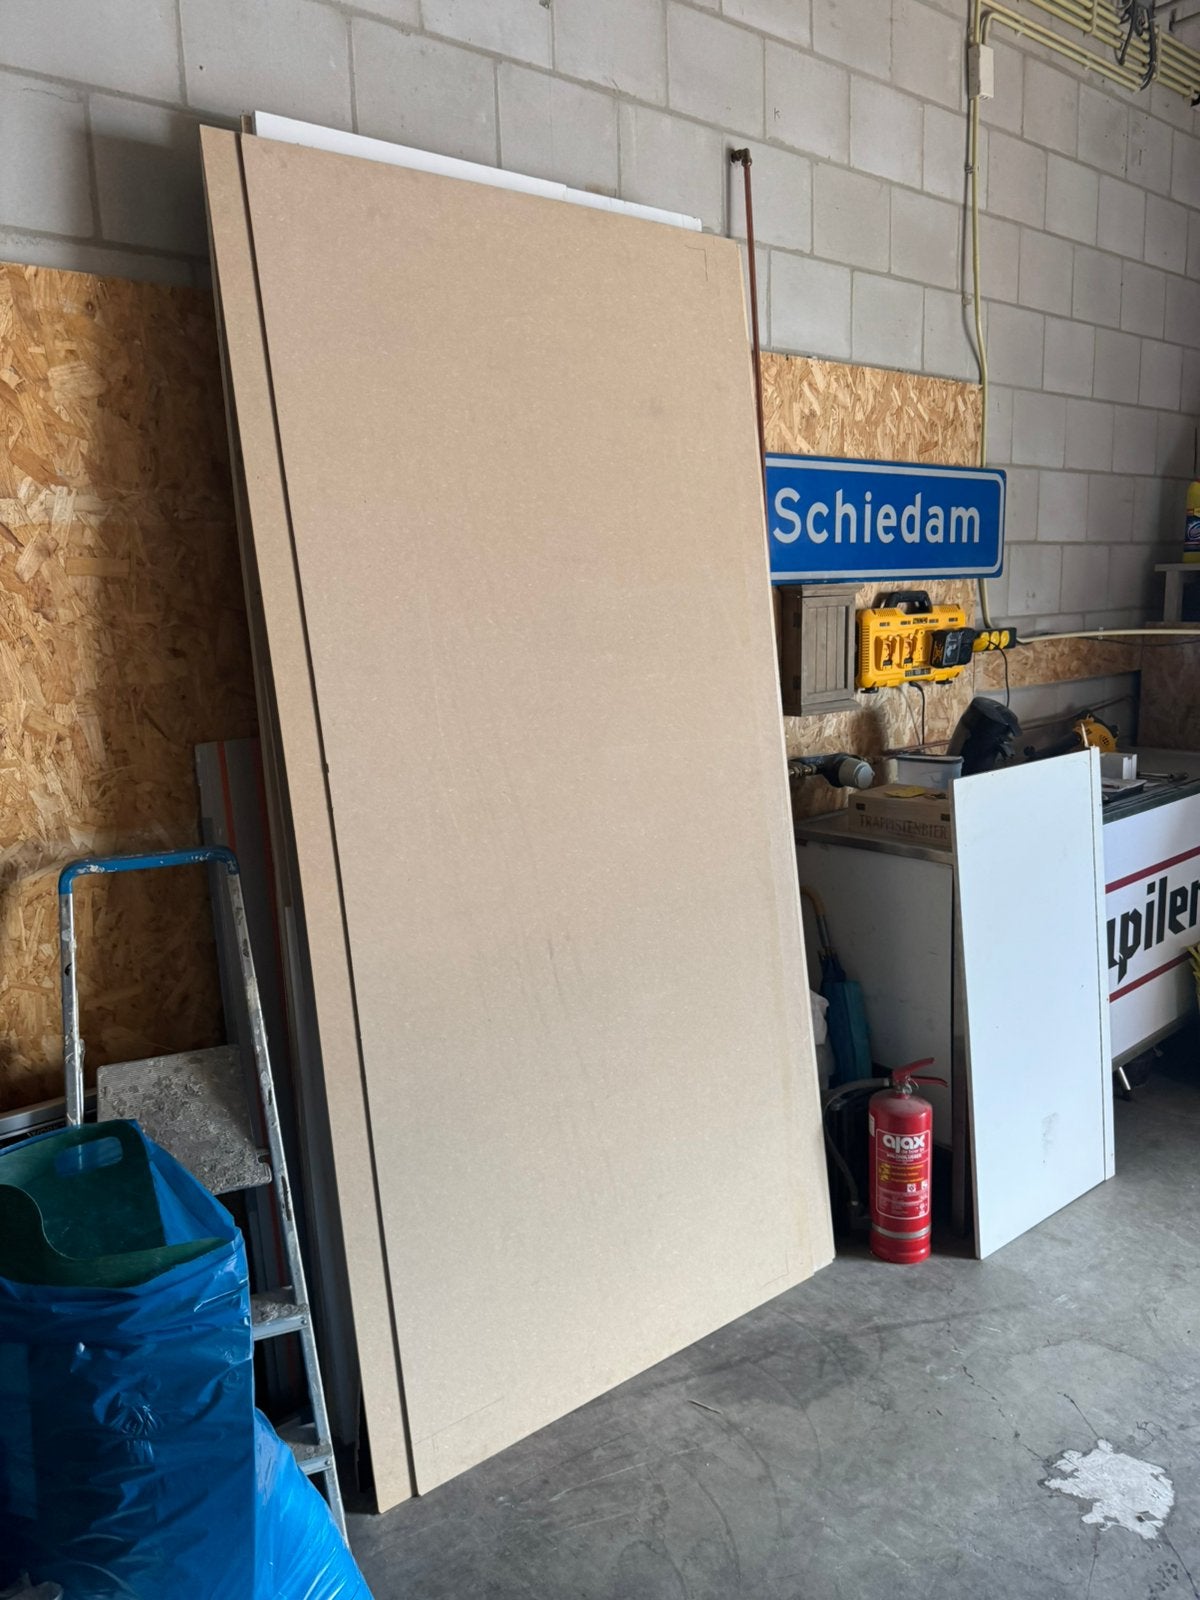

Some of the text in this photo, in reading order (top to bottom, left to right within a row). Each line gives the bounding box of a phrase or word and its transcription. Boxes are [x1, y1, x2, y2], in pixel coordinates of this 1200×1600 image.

[773, 487, 981, 544] Schiedam
[859, 814, 947, 840] TRAPPISTENBIER
[882, 1134, 925, 1154] ajax
